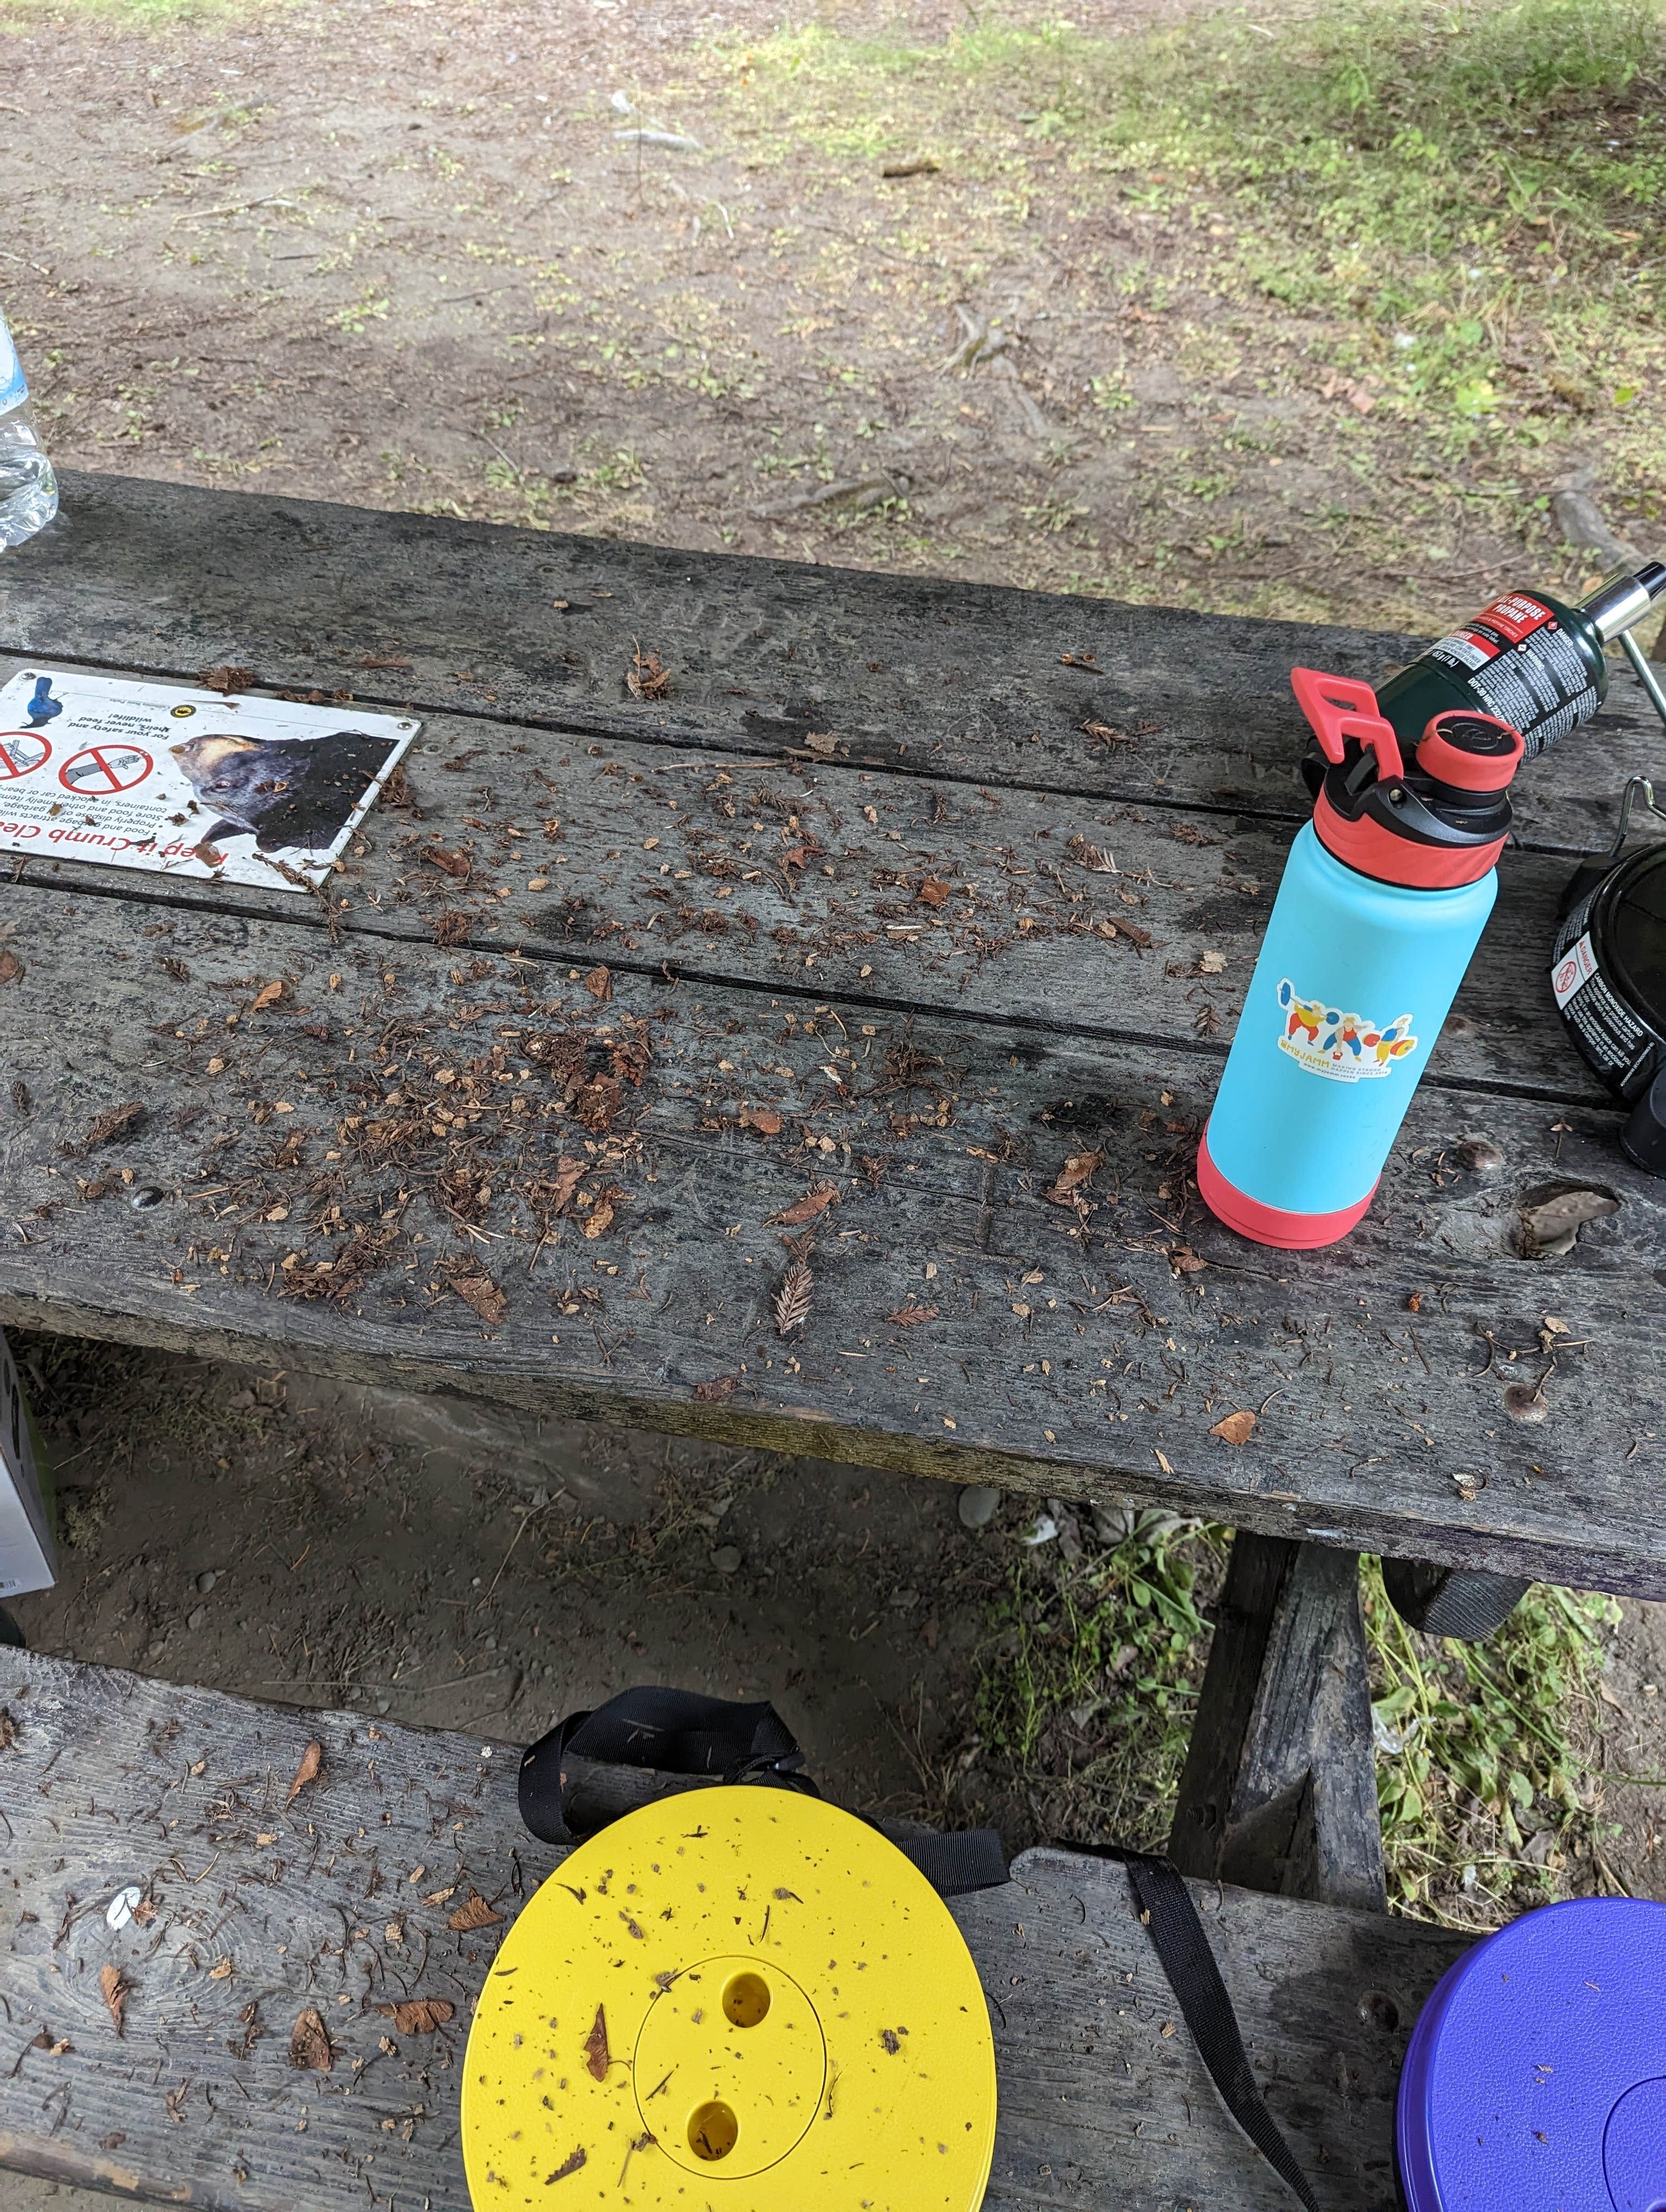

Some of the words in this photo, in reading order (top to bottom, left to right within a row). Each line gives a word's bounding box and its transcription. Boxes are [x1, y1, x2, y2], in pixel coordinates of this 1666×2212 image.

[1492, 602, 1528, 624] PROPANE
[1487, 635, 1500, 644] label.
[1555, 627, 1574, 649] DANGER:
[1524, 648, 1545, 671] WARNING:
[1466, 676, 1486, 698] DOT-39
[1481, 693, 1495, 708] NRC
[108, 714, 151, 722] wildlife!
[25, 796, 56, 806] smelly
[56, 794, 90, 803] locked
[4, 802, 47, 812] garbage,
[108, 809, 133, 817] food
[115, 801, 167, 813] containers,
[20, 813, 58, 821] attracts
[75, 813, 112, 821] dispose
[114, 816, 156, 828] Properly
[123, 827, 150, 835] Food
[49, 831, 130, 850] Crumb
[164, 844, 227, 865] Kep
[1580, 946, 1593, 975] DANGER
[1593, 972, 1608, 993] CARBON
[1604, 992, 1627, 1018] MONOXIDE
[1623, 1015, 1644, 1037] HAZARD
[1604, 1003, 1612, 1012] can
[1608, 1010, 1624, 1027] produce
[1620, 1025, 1636, 1040] carbon
[1603, 1014, 1622, 1036] poisonous
[1619, 1033, 1630, 1043] and
[1625, 1040, 1636, 1051] has
[1599, 1032, 1613, 1045] space
[1610, 1043, 1619, 1052] can
[1616, 1049, 1625, 1058] kill
[1621, 1055, 1633, 1067] you.
[1601, 1053, 1610, 1062] car
[1607, 1059, 1614, 1067] or
[1606, 1049, 1625, 1068] enclosed
